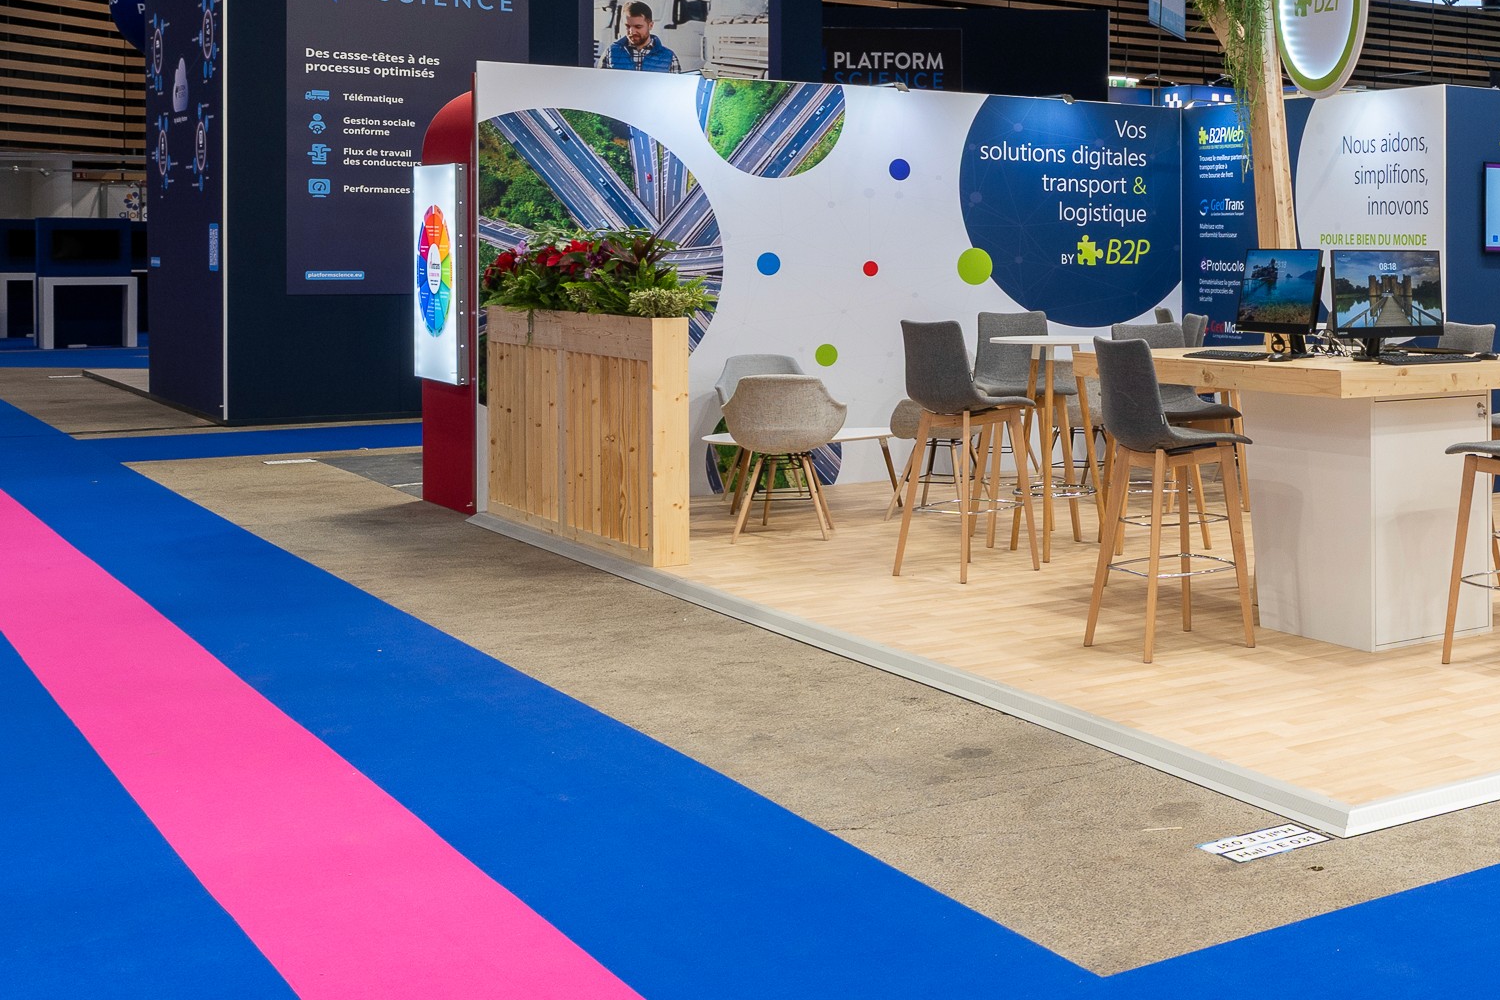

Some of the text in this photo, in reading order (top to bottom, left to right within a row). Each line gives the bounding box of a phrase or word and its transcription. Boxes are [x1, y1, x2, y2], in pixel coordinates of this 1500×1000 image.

[305, 47, 440, 66] Des casse-têtes à des
[833, 51, 944, 70] PLATFORM
[305, 62, 435, 79] processus optimisés
[834, 71, 944, 89] SCIENCE
[343, 92, 404, 105] Télématique
[343, 116, 416, 128] Gestion sociale
[1115, 120, 1147, 139] Vos
[343, 127, 390, 136] conforme
[1209, 125, 1244, 144] B2PWeb
[1342, 132, 1428, 154] Nous aidons,
[343, 147, 412, 158] Flux de travail
[980, 141, 1147, 170] solutions digitales
[343, 157, 422, 168] des conducteurs
[1354, 163, 1428, 189] simplifions,
[343, 184, 410, 195] Performances
[1042, 174, 1147, 198] transport &
[1210, 198, 1244, 211] GedTrans
[1368, 196, 1429, 215] innovons
[1059, 201, 1147, 227] logistique
[1320, 233, 1427, 246] POUR LE BIEN DU MONDE
[1061, 239, 1150, 265] BY B2P
[1379, 262, 1397, 271] 08:18
